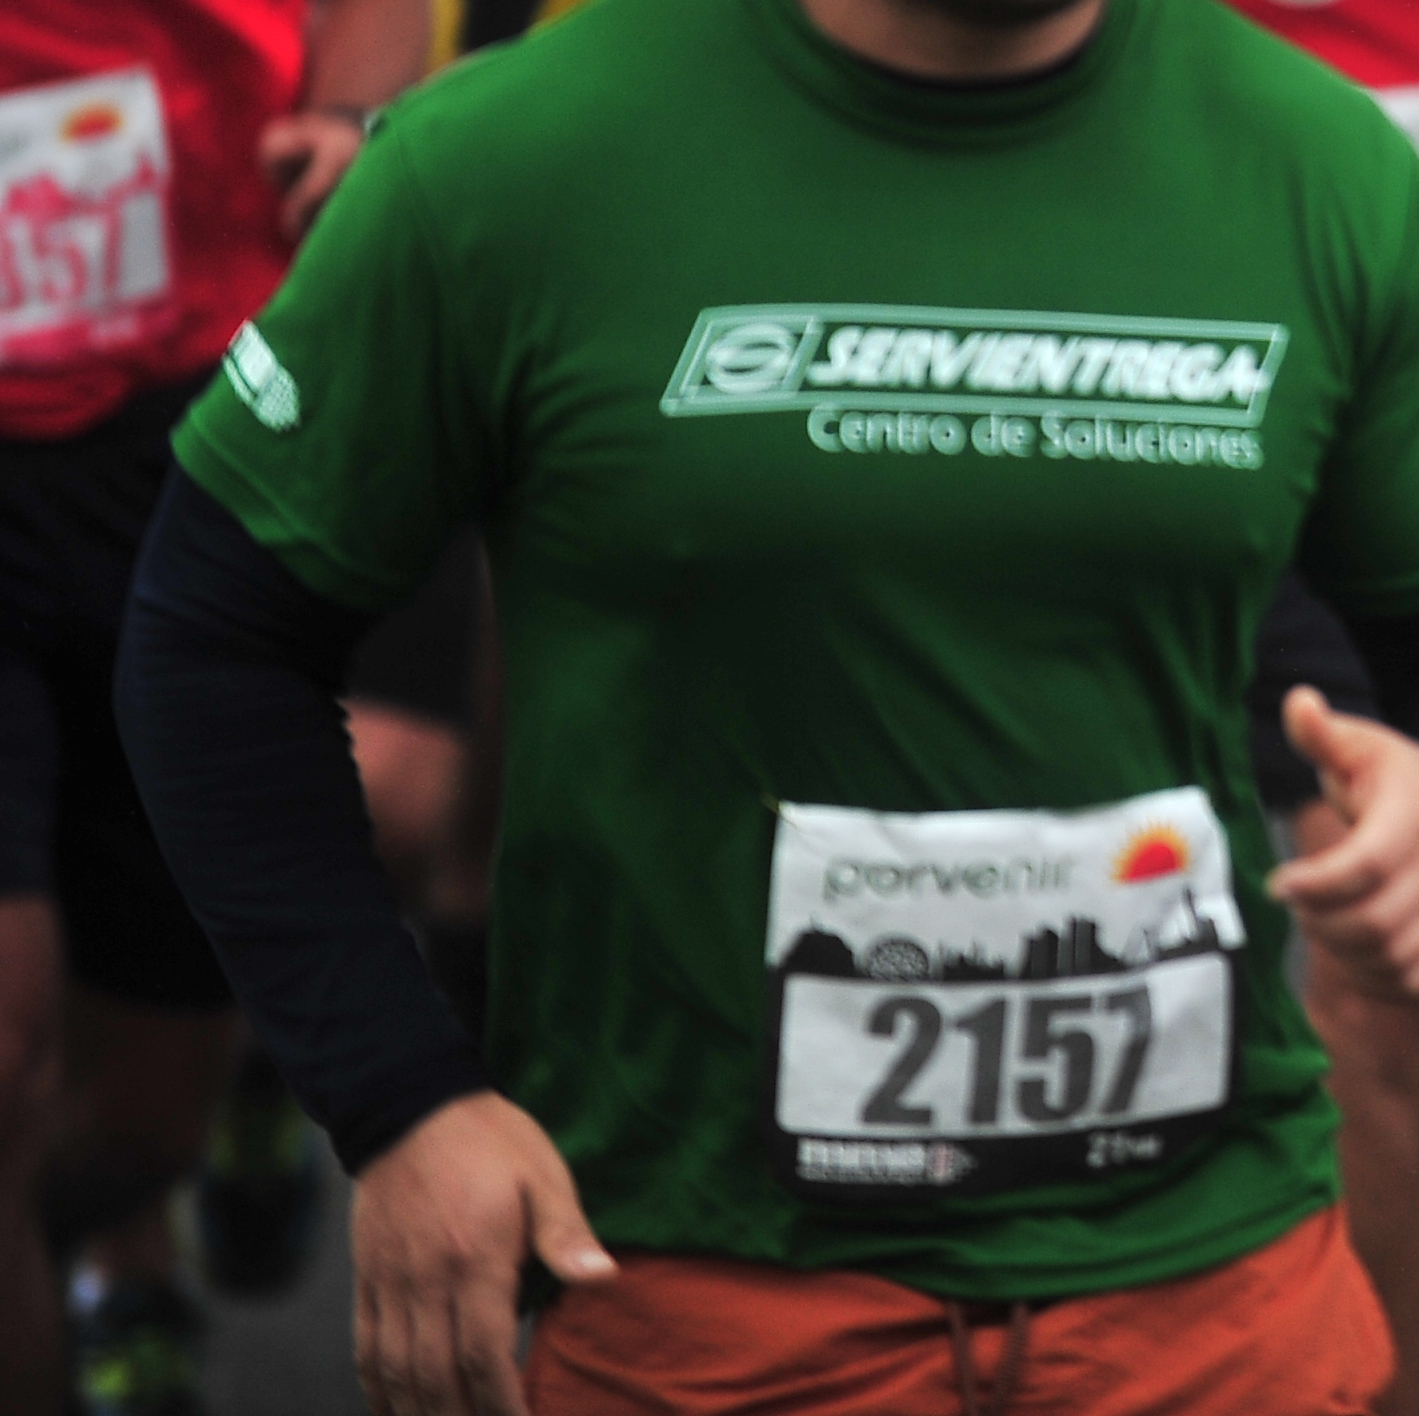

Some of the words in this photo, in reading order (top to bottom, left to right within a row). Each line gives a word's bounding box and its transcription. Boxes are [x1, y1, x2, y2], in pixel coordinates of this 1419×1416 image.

[806, 326, 1272, 405] SERVIENTREGA
[807, 404, 967, 455] Centro
[971, 411, 1036, 458] de
[1040, 411, 1264, 471] Soluciones
[823, 859, 1084, 901] porvenir
[856, 984, 1154, 1128] 2157
